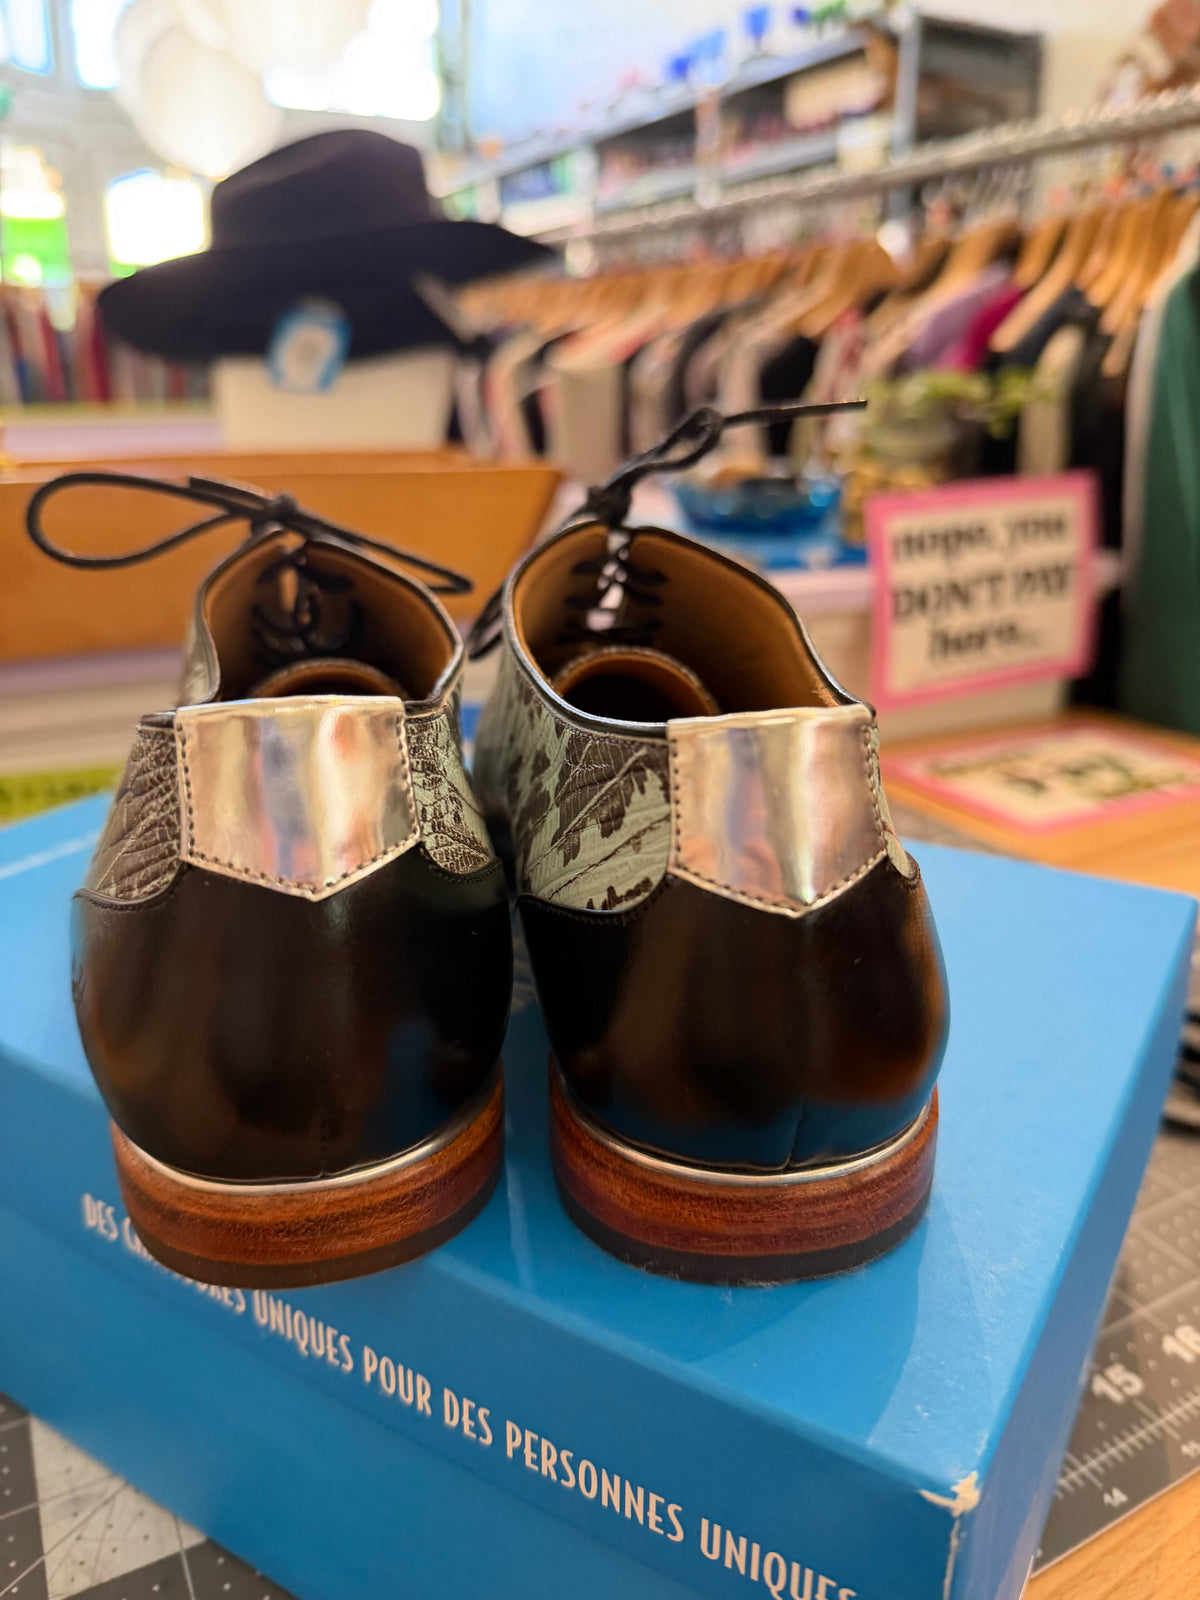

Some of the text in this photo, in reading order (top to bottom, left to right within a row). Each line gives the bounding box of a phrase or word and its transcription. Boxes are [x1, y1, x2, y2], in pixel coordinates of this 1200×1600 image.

[81, 1192, 119, 1241] DES
[252, 1290, 353, 1372] UNIQUES
[363, 1346, 432, 1416] POUR
[443, 1387, 493, 1447] DES
[506, 1420, 685, 1543] PERSONNES
[1092, 1364, 1144, 1404] 15
